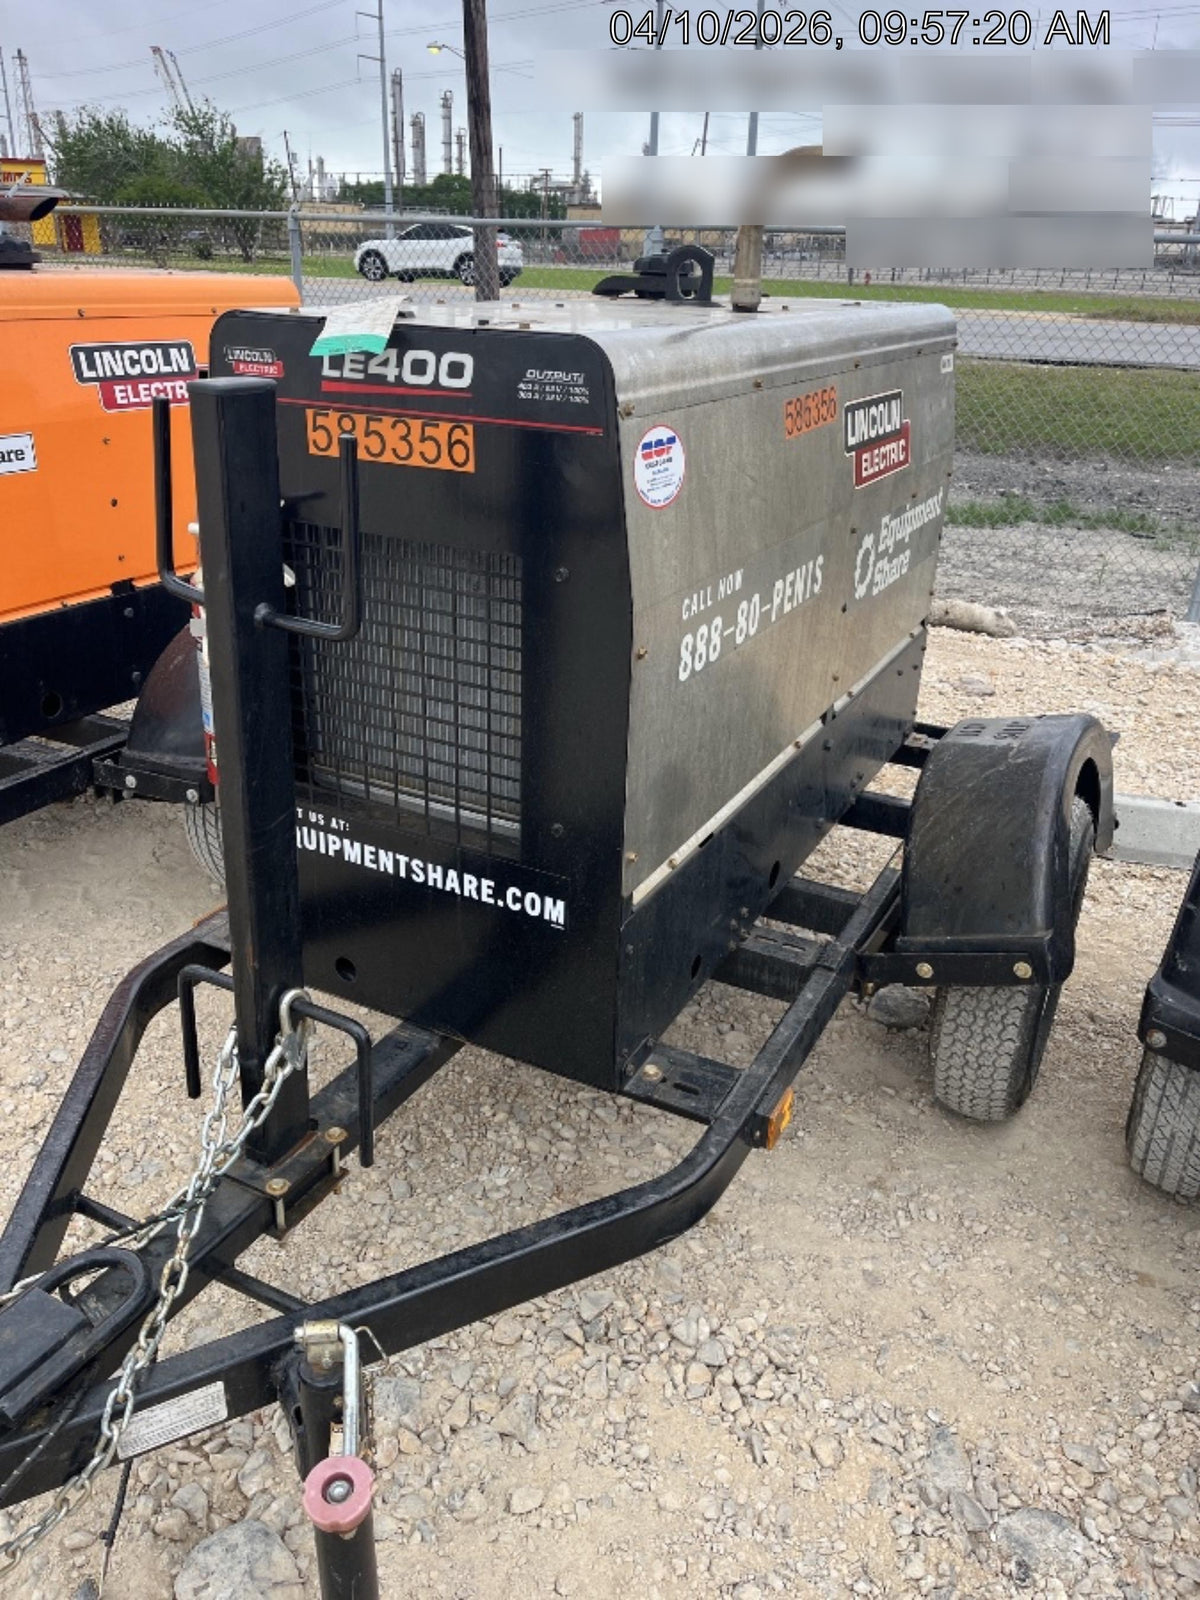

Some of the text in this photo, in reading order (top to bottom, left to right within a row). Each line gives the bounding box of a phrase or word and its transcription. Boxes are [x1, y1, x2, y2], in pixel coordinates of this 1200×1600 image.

[78, 348, 190, 378] LINCOLN
[227, 349, 273, 363] LINCOLN
[239, 362, 278, 374] ELECTRIC
[321, 348, 474, 388] LE400
[525, 369, 580, 382] OUTPUT
[847, 398, 901, 447] LINCOLN
[861, 439, 906, 478] ELECTRIC
[878, 486, 943, 553] Equipment
[873, 549, 911, 596] Share
[682, 569, 744, 620] CALL NOW
[308, 811, 324, 825] US
[330, 817, 350, 831] AT:
